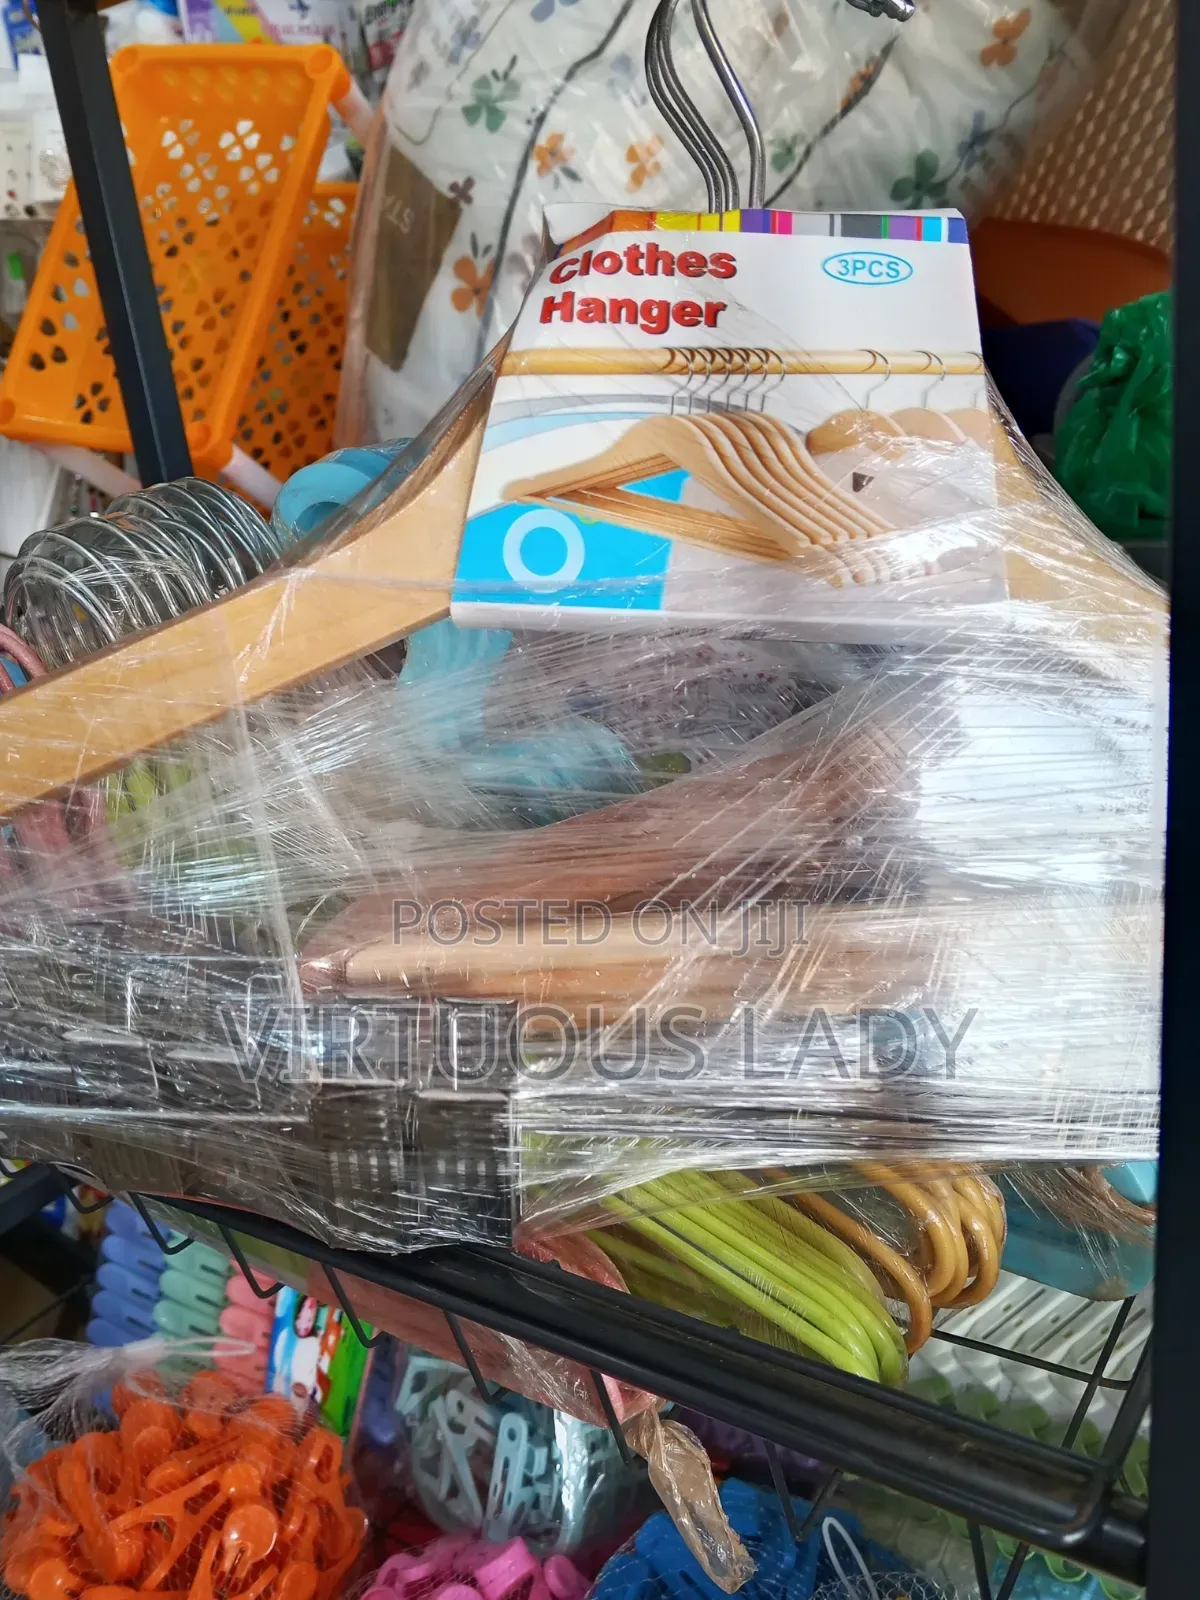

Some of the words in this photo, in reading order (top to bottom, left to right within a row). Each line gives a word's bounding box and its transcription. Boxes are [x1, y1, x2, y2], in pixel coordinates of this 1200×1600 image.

[549, 242, 738, 284] Clothes
[837, 258, 900, 279] 3PCS
[539, 290, 728, 335] Hanger
